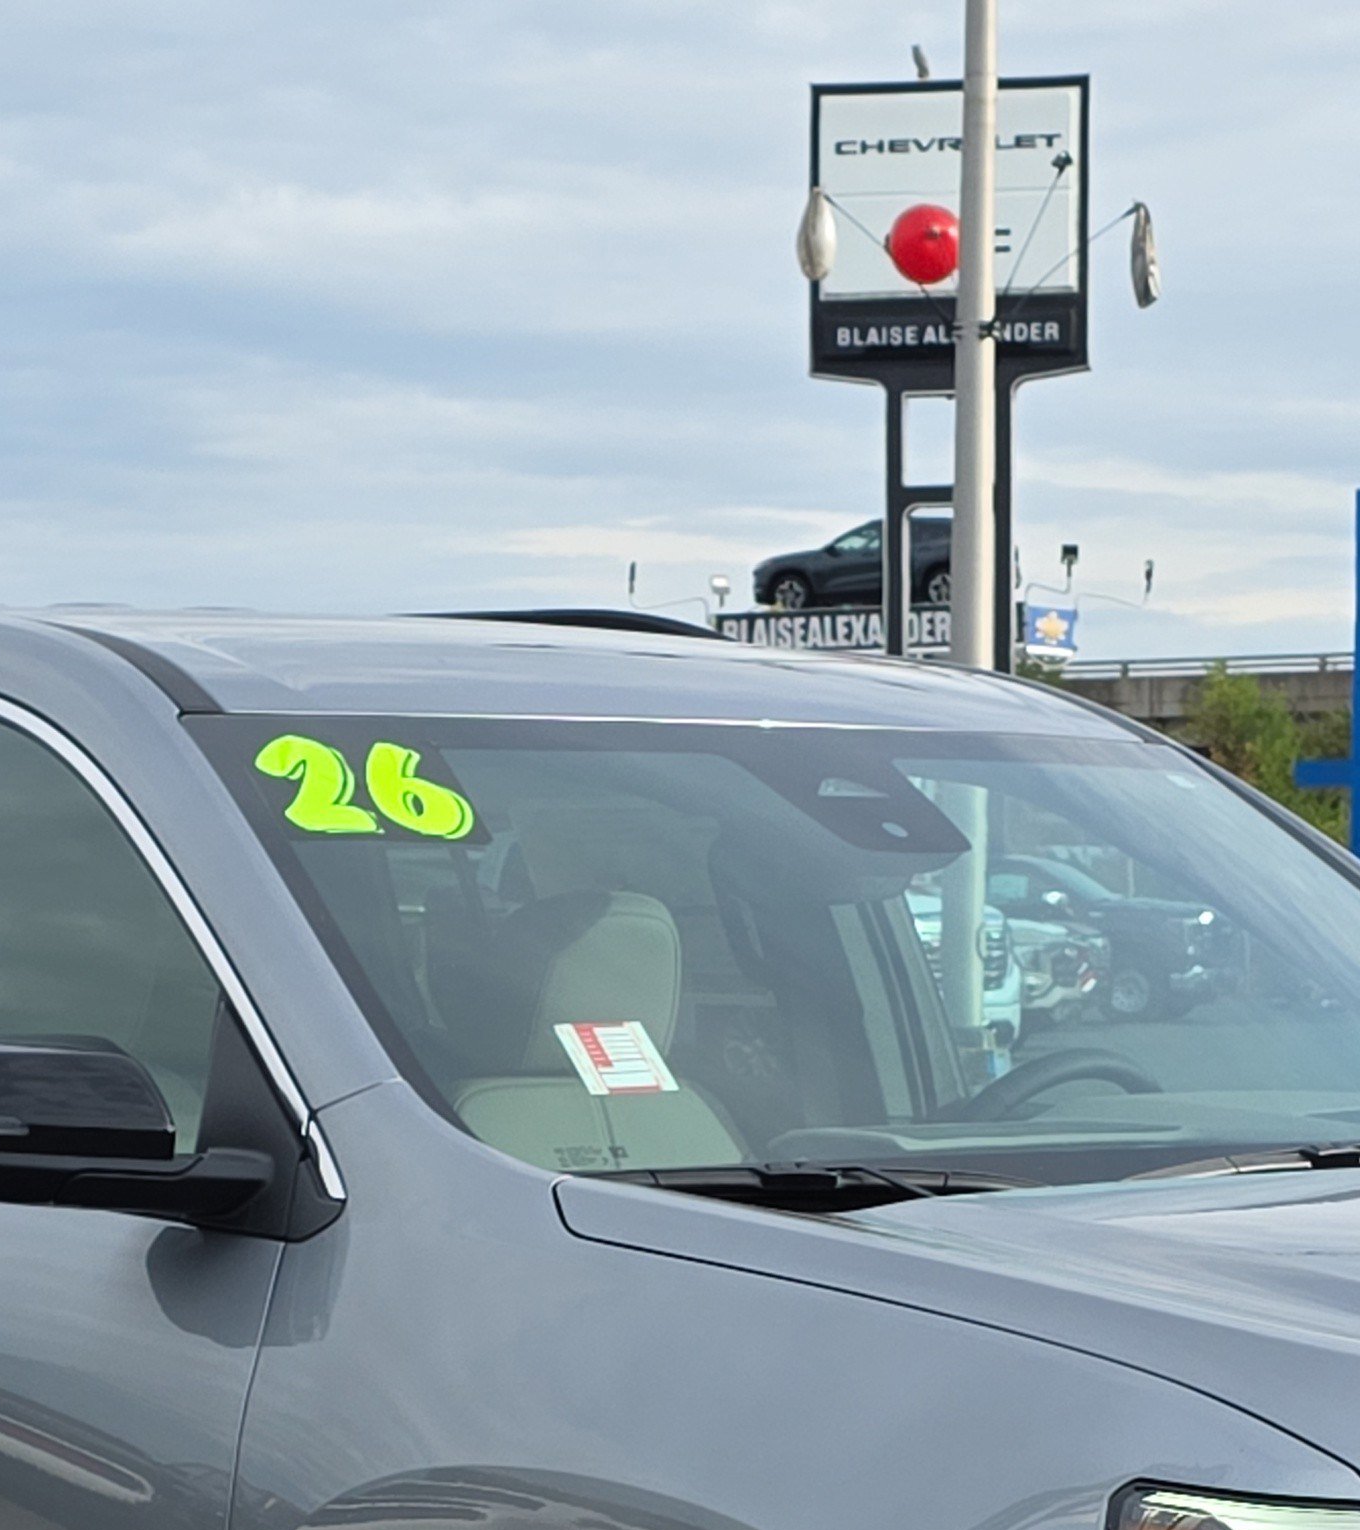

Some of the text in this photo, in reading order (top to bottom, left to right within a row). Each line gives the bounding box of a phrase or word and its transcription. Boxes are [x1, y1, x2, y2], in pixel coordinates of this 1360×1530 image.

[835, 133, 1061, 155] CHEVRLET
[837, 321, 1060, 347] BLAISE ALNDER
[723, 610, 951, 648] BLAISEALEXADER
[254, 733, 474, 841] 26
